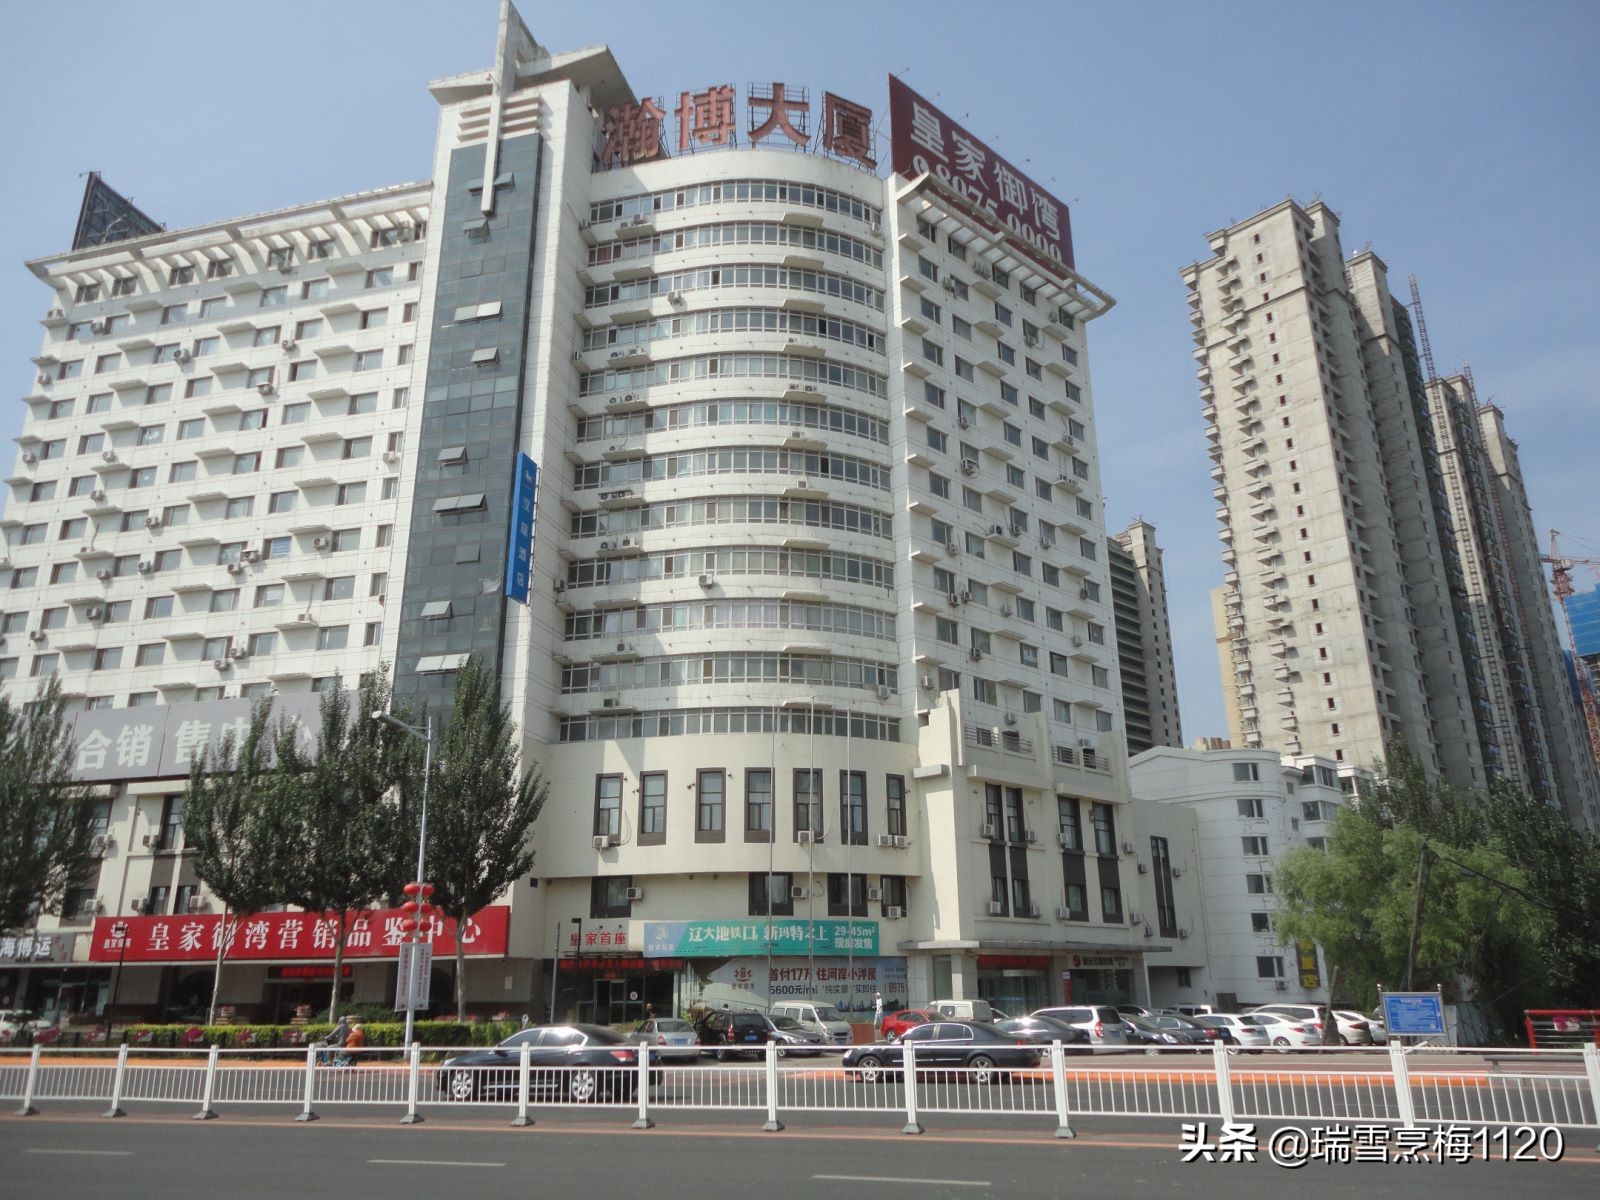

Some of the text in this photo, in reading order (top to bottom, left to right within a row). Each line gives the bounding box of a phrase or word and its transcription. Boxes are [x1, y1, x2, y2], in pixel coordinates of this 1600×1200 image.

[602, 82, 878, 164] 瀚博大厦
[911, 102, 1061, 241] 皇家御湾
[145, 914, 481, 952] 皇家御湾营销品鉴中心
[570, 931, 627, 946] 皇家首座
